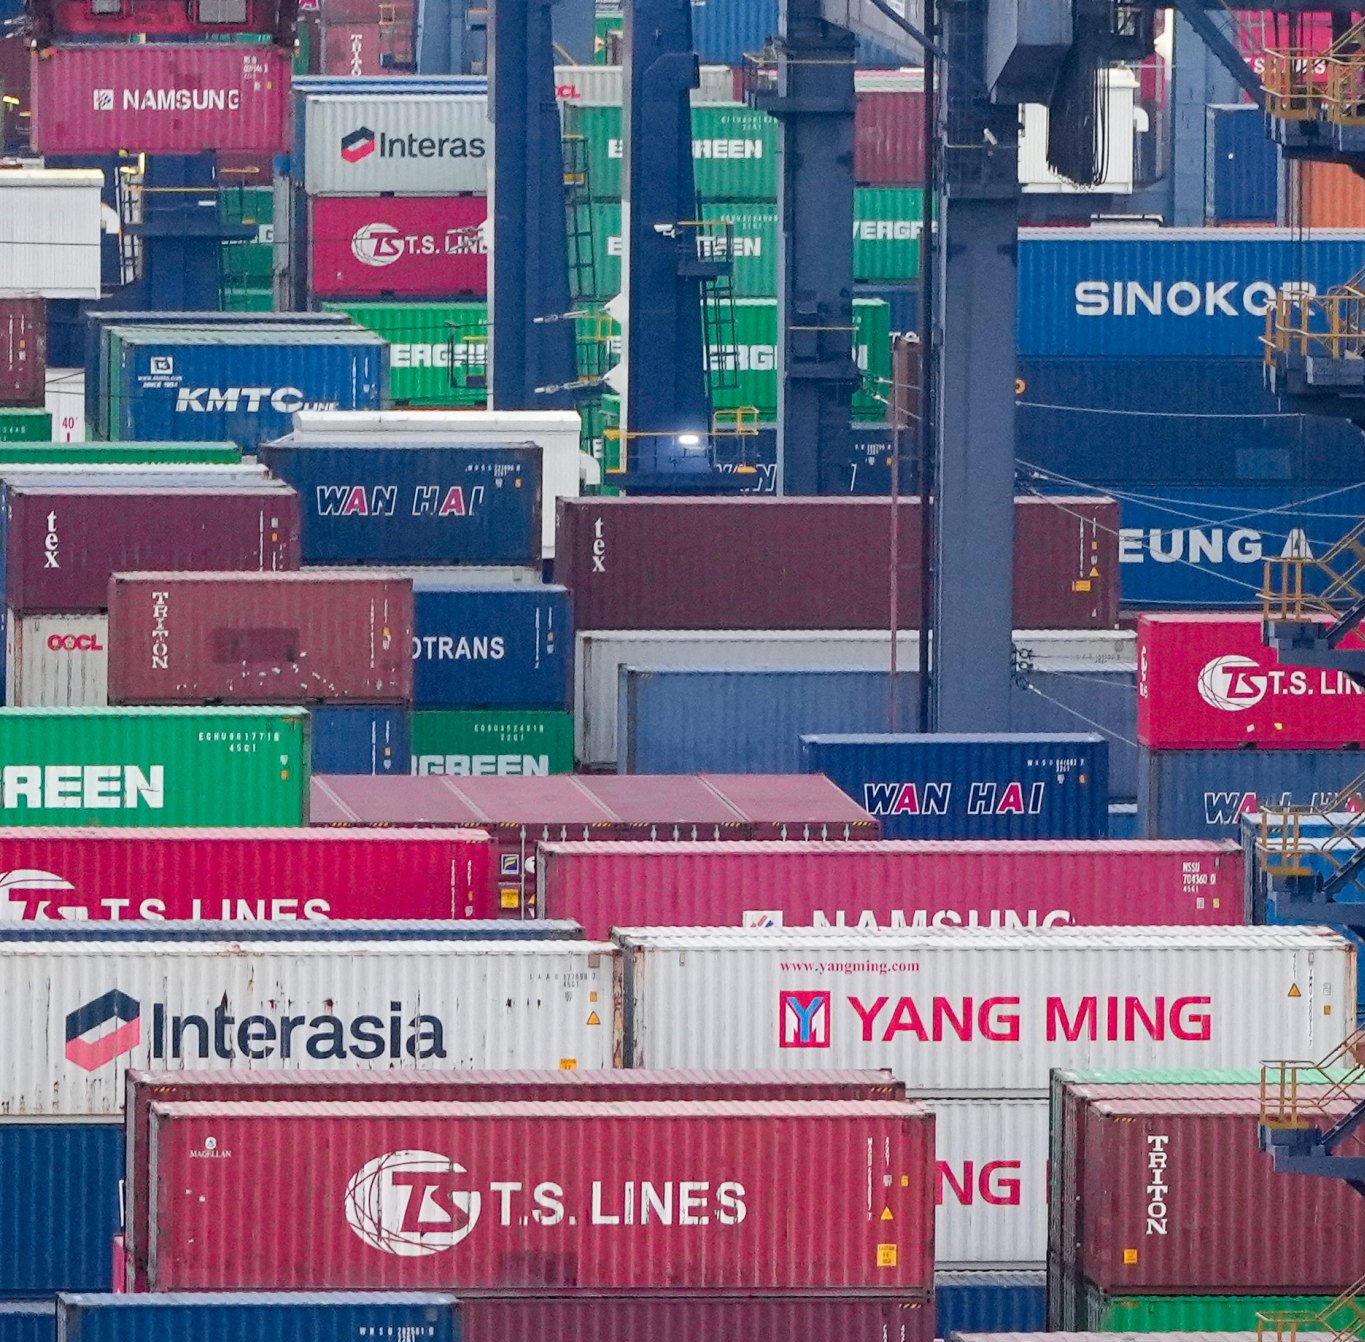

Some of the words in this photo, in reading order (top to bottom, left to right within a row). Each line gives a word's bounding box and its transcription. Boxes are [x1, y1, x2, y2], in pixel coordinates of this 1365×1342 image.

[122, 89, 240, 111] NAMSUNG
[380, 131, 486, 159] Interas
[1074, 281, 1316, 317] SINOKOR
[181, 387, 310, 412] KMTC
[316, 485, 398, 516] WAN
[412, 485, 485, 516] HAI
[43, 509, 60, 569] tex
[591, 516, 606, 573] tex
[47, 633, 104, 652] OOCL
[152, 591, 169, 669] TRITON
[1268, 670, 1314, 695] T.S.
[865, 782, 952, 815] WAN
[968, 782, 1045, 815] HAI
[780, 959, 920, 975] www.yangming.com
[153, 1000, 447, 1060] Interasia
[847, 996, 1021, 1042] YANG
[1045, 996, 1212, 1042] MING
[189, 1150, 232, 1159] MAGELLAN
[1146, 1135, 1169, 1235] TRITON
[489, 1180, 578, 1227] T.S.
[592, 1180, 747, 1227] LINES
